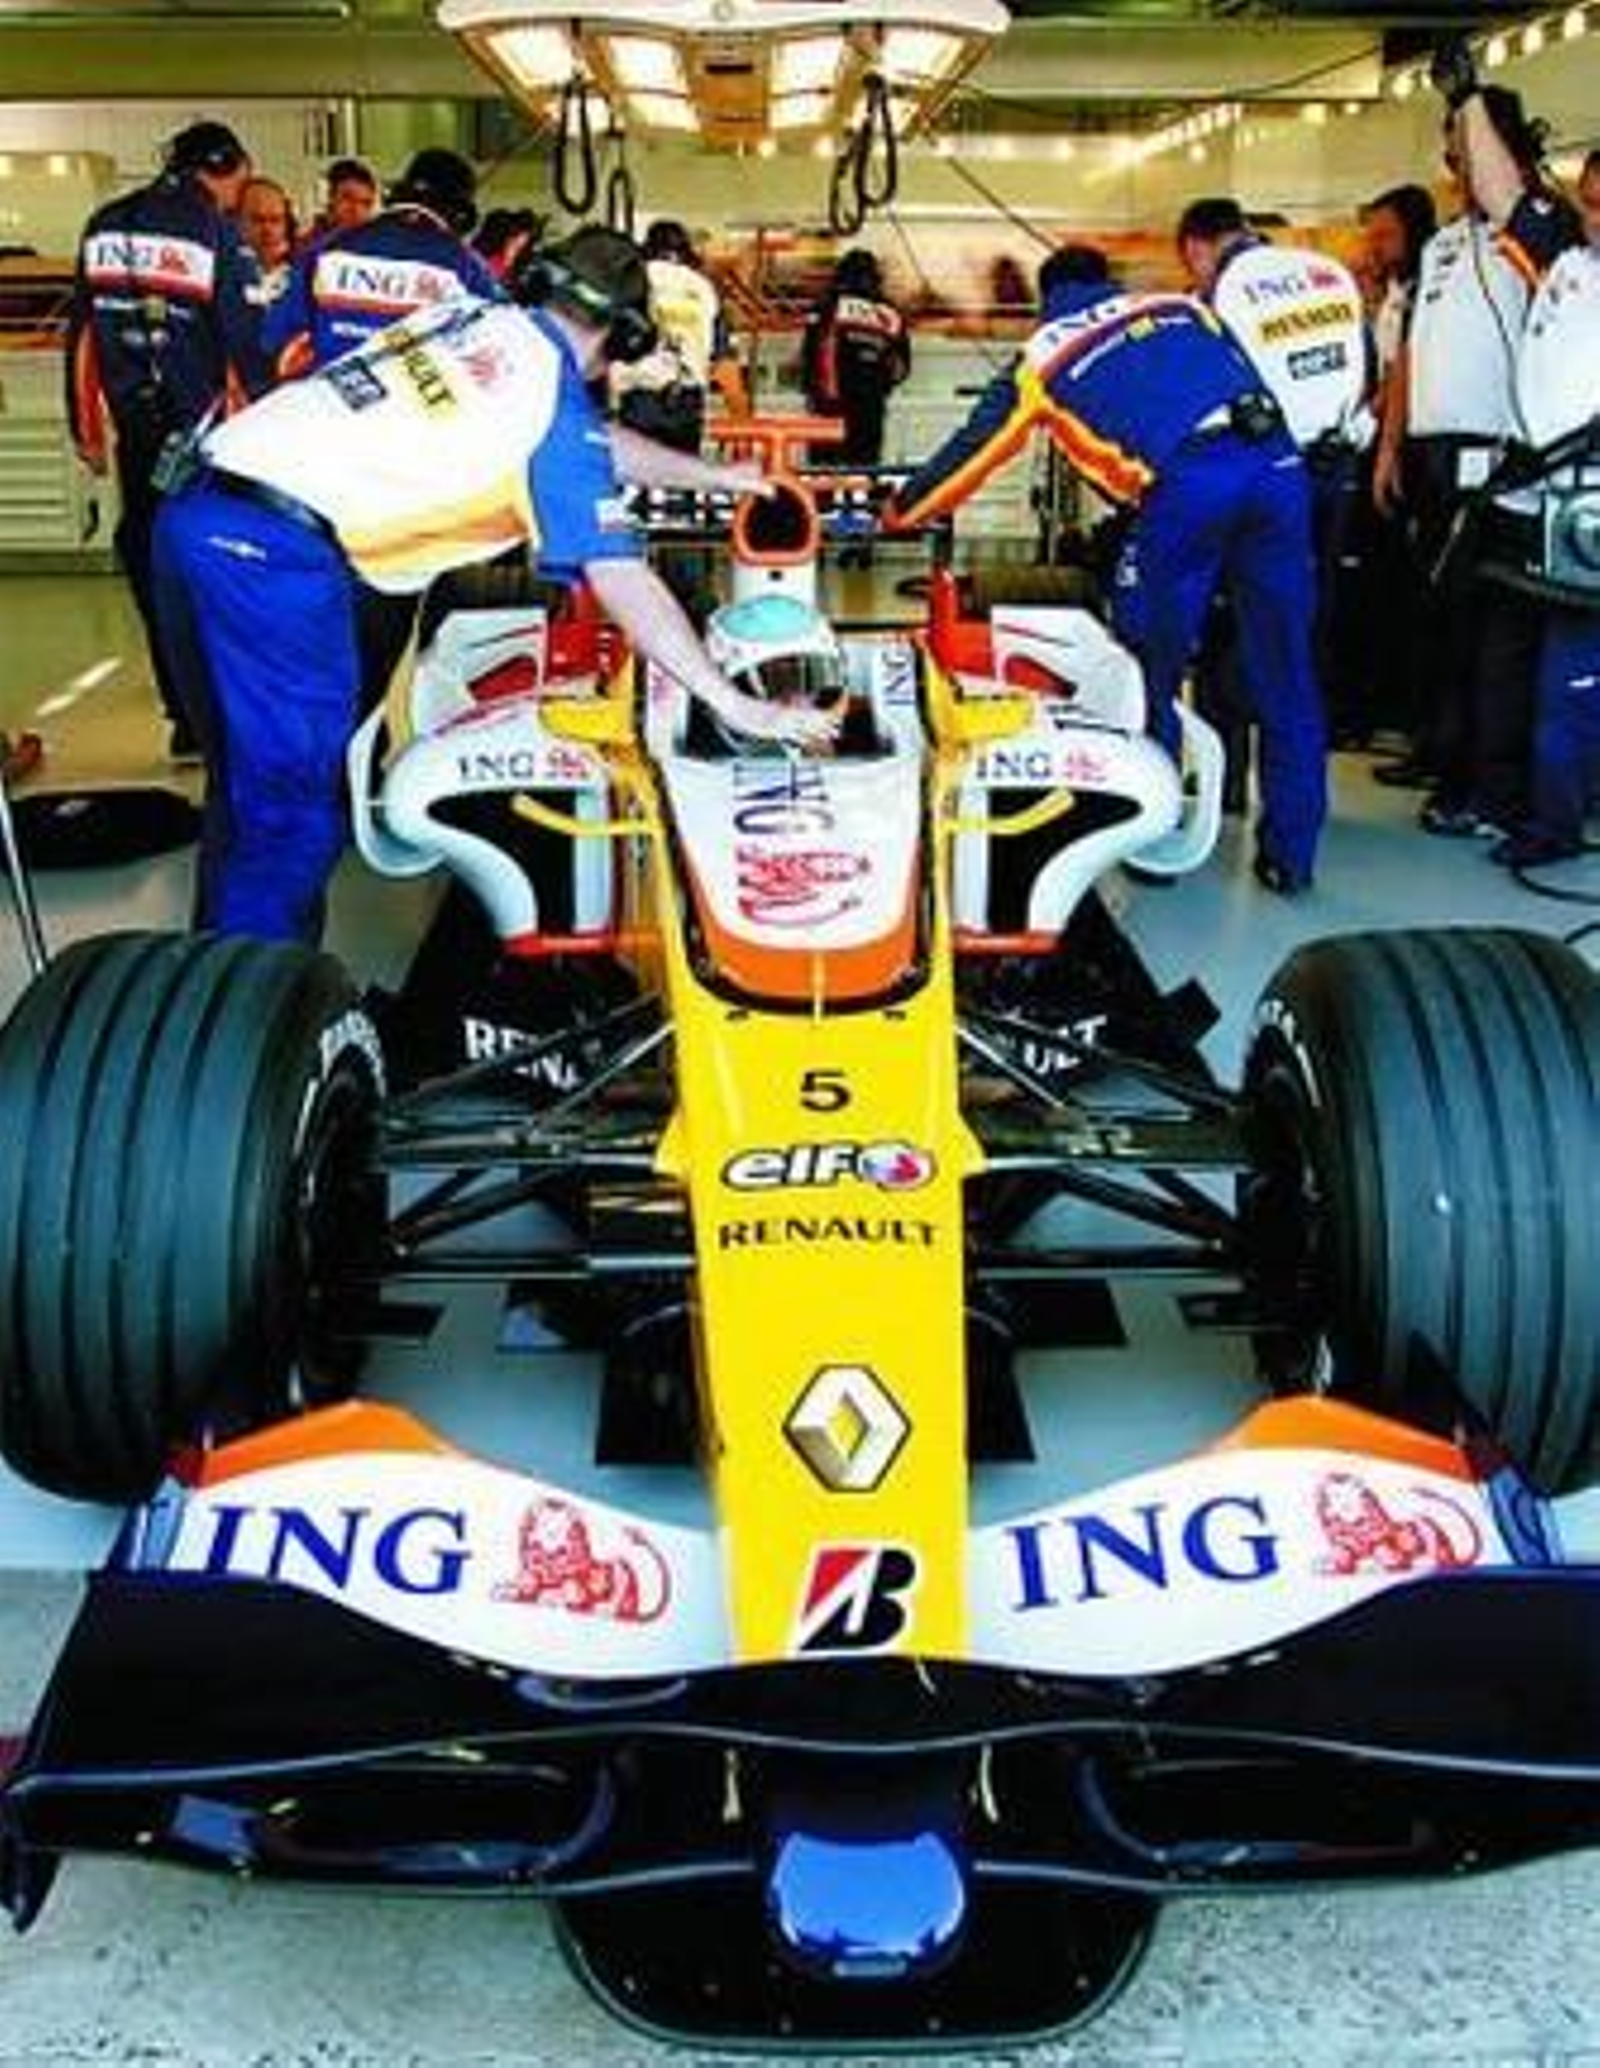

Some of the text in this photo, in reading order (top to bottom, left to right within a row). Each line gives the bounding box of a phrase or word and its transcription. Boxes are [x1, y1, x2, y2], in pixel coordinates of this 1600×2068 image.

[336, 264, 406, 295] ING
[458, 750, 534, 782] ING
[976, 750, 1052, 781] ING
[800, 1069, 851, 1113] 5
[718, 1217, 936, 1249] RENAULT
[204, 1506, 472, 1595] ING
[1010, 1495, 1280, 1613] ING
